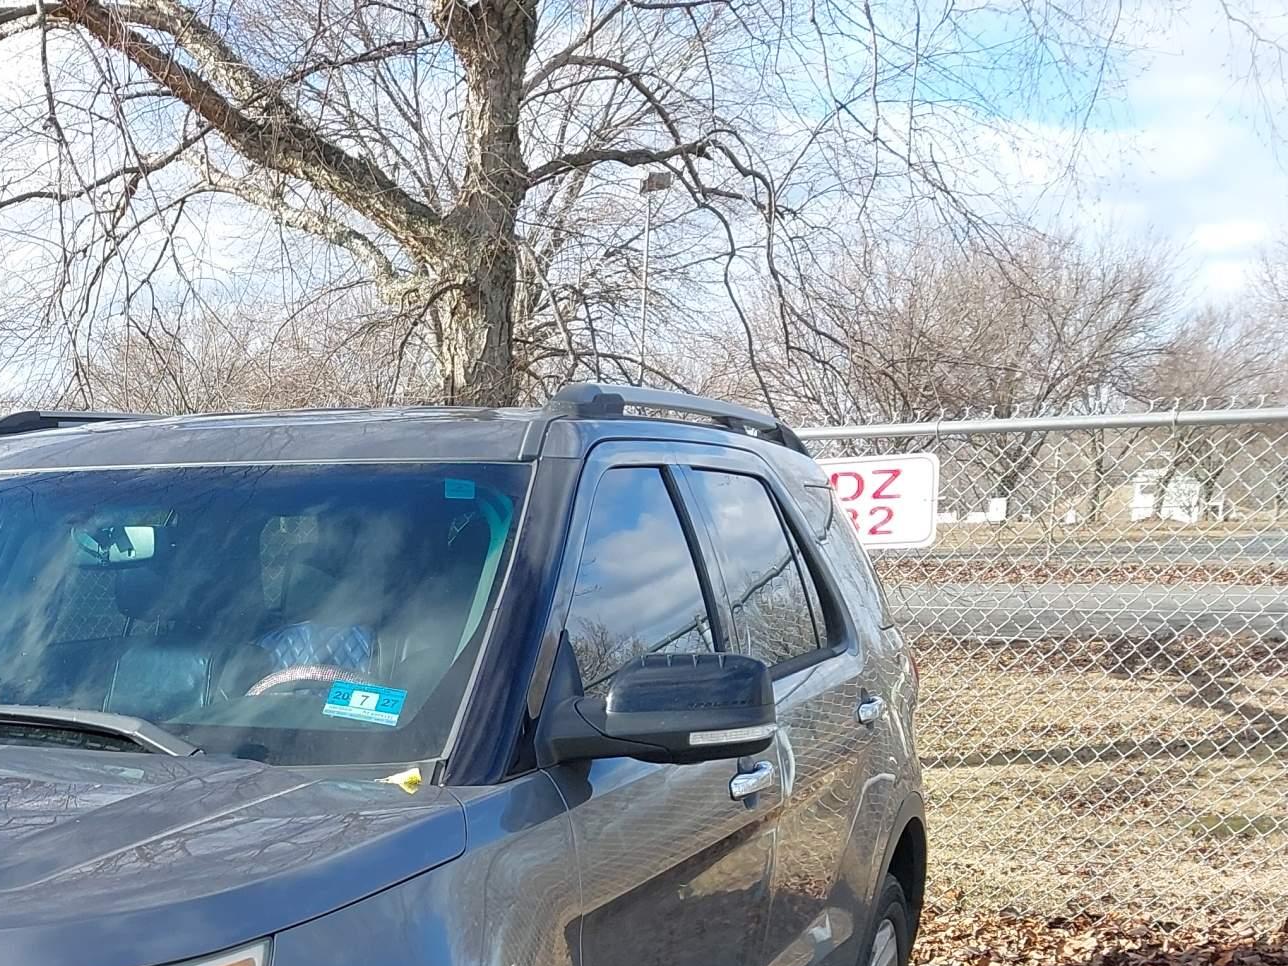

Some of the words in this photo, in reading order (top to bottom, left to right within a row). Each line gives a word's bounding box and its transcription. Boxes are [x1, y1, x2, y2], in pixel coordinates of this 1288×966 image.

[830, 469, 902, 501] DZ
[332, 690, 350, 701] 20
[360, 694, 370, 706] 7
[380, 698, 399, 709] 27
